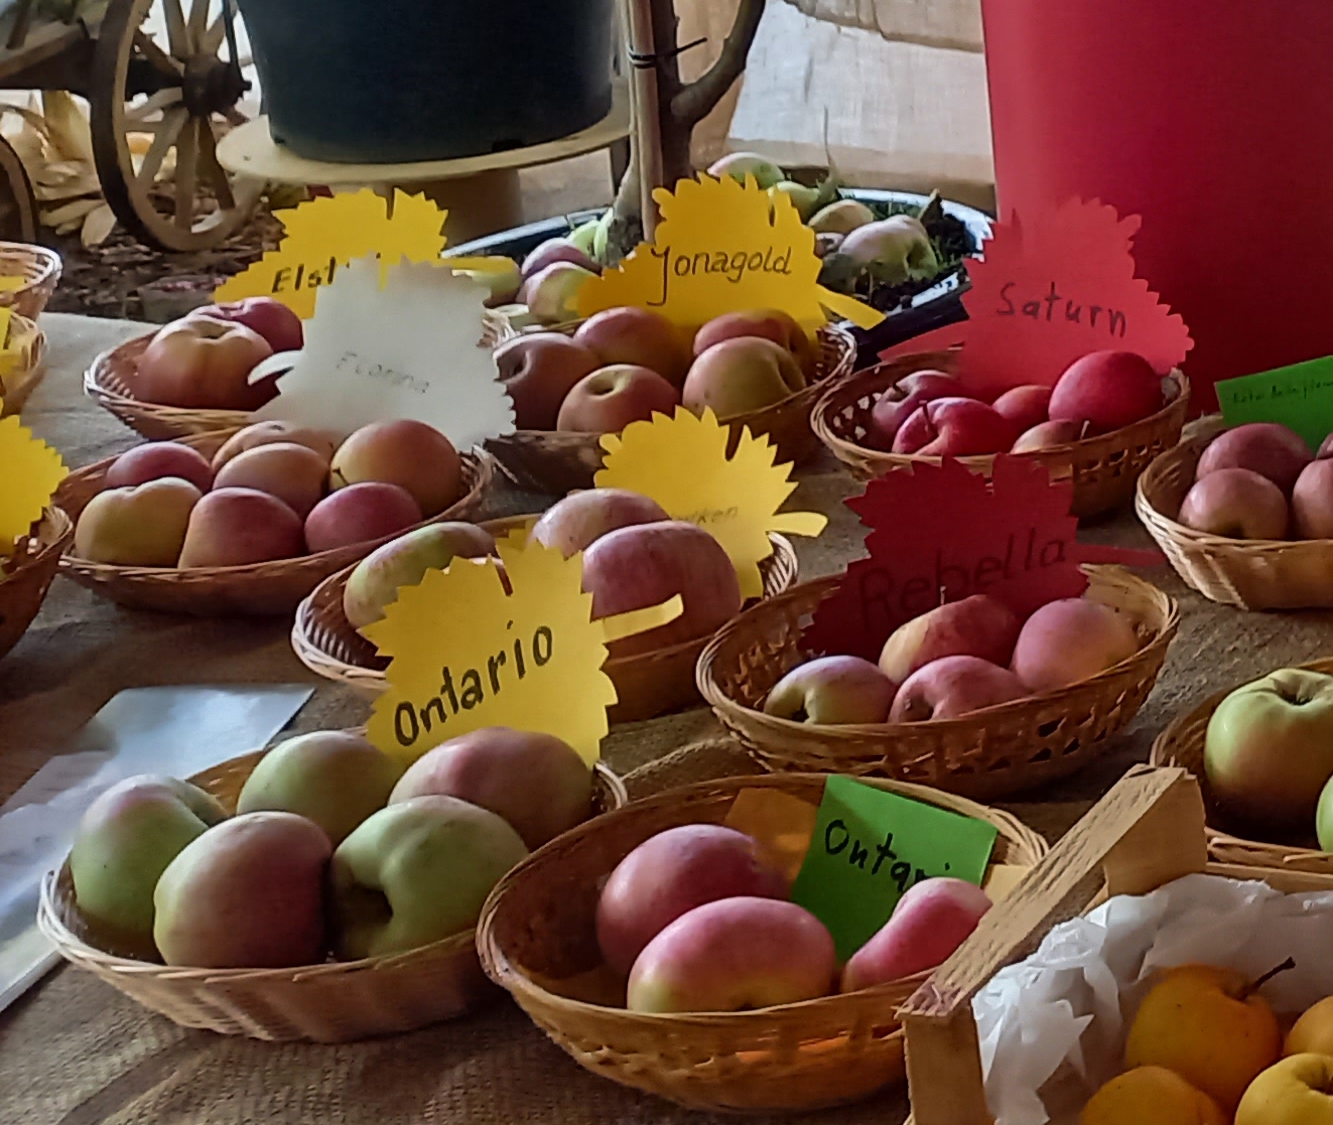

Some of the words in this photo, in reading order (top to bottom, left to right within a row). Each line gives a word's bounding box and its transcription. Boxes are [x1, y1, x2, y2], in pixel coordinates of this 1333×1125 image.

[271, 253, 362, 293] Elst
[646, 245, 792, 306] Jonagold
[996, 281, 1127, 338] Saturn
[858, 527, 1066, 631] Rebella
[394, 619, 553, 746] Ontario
